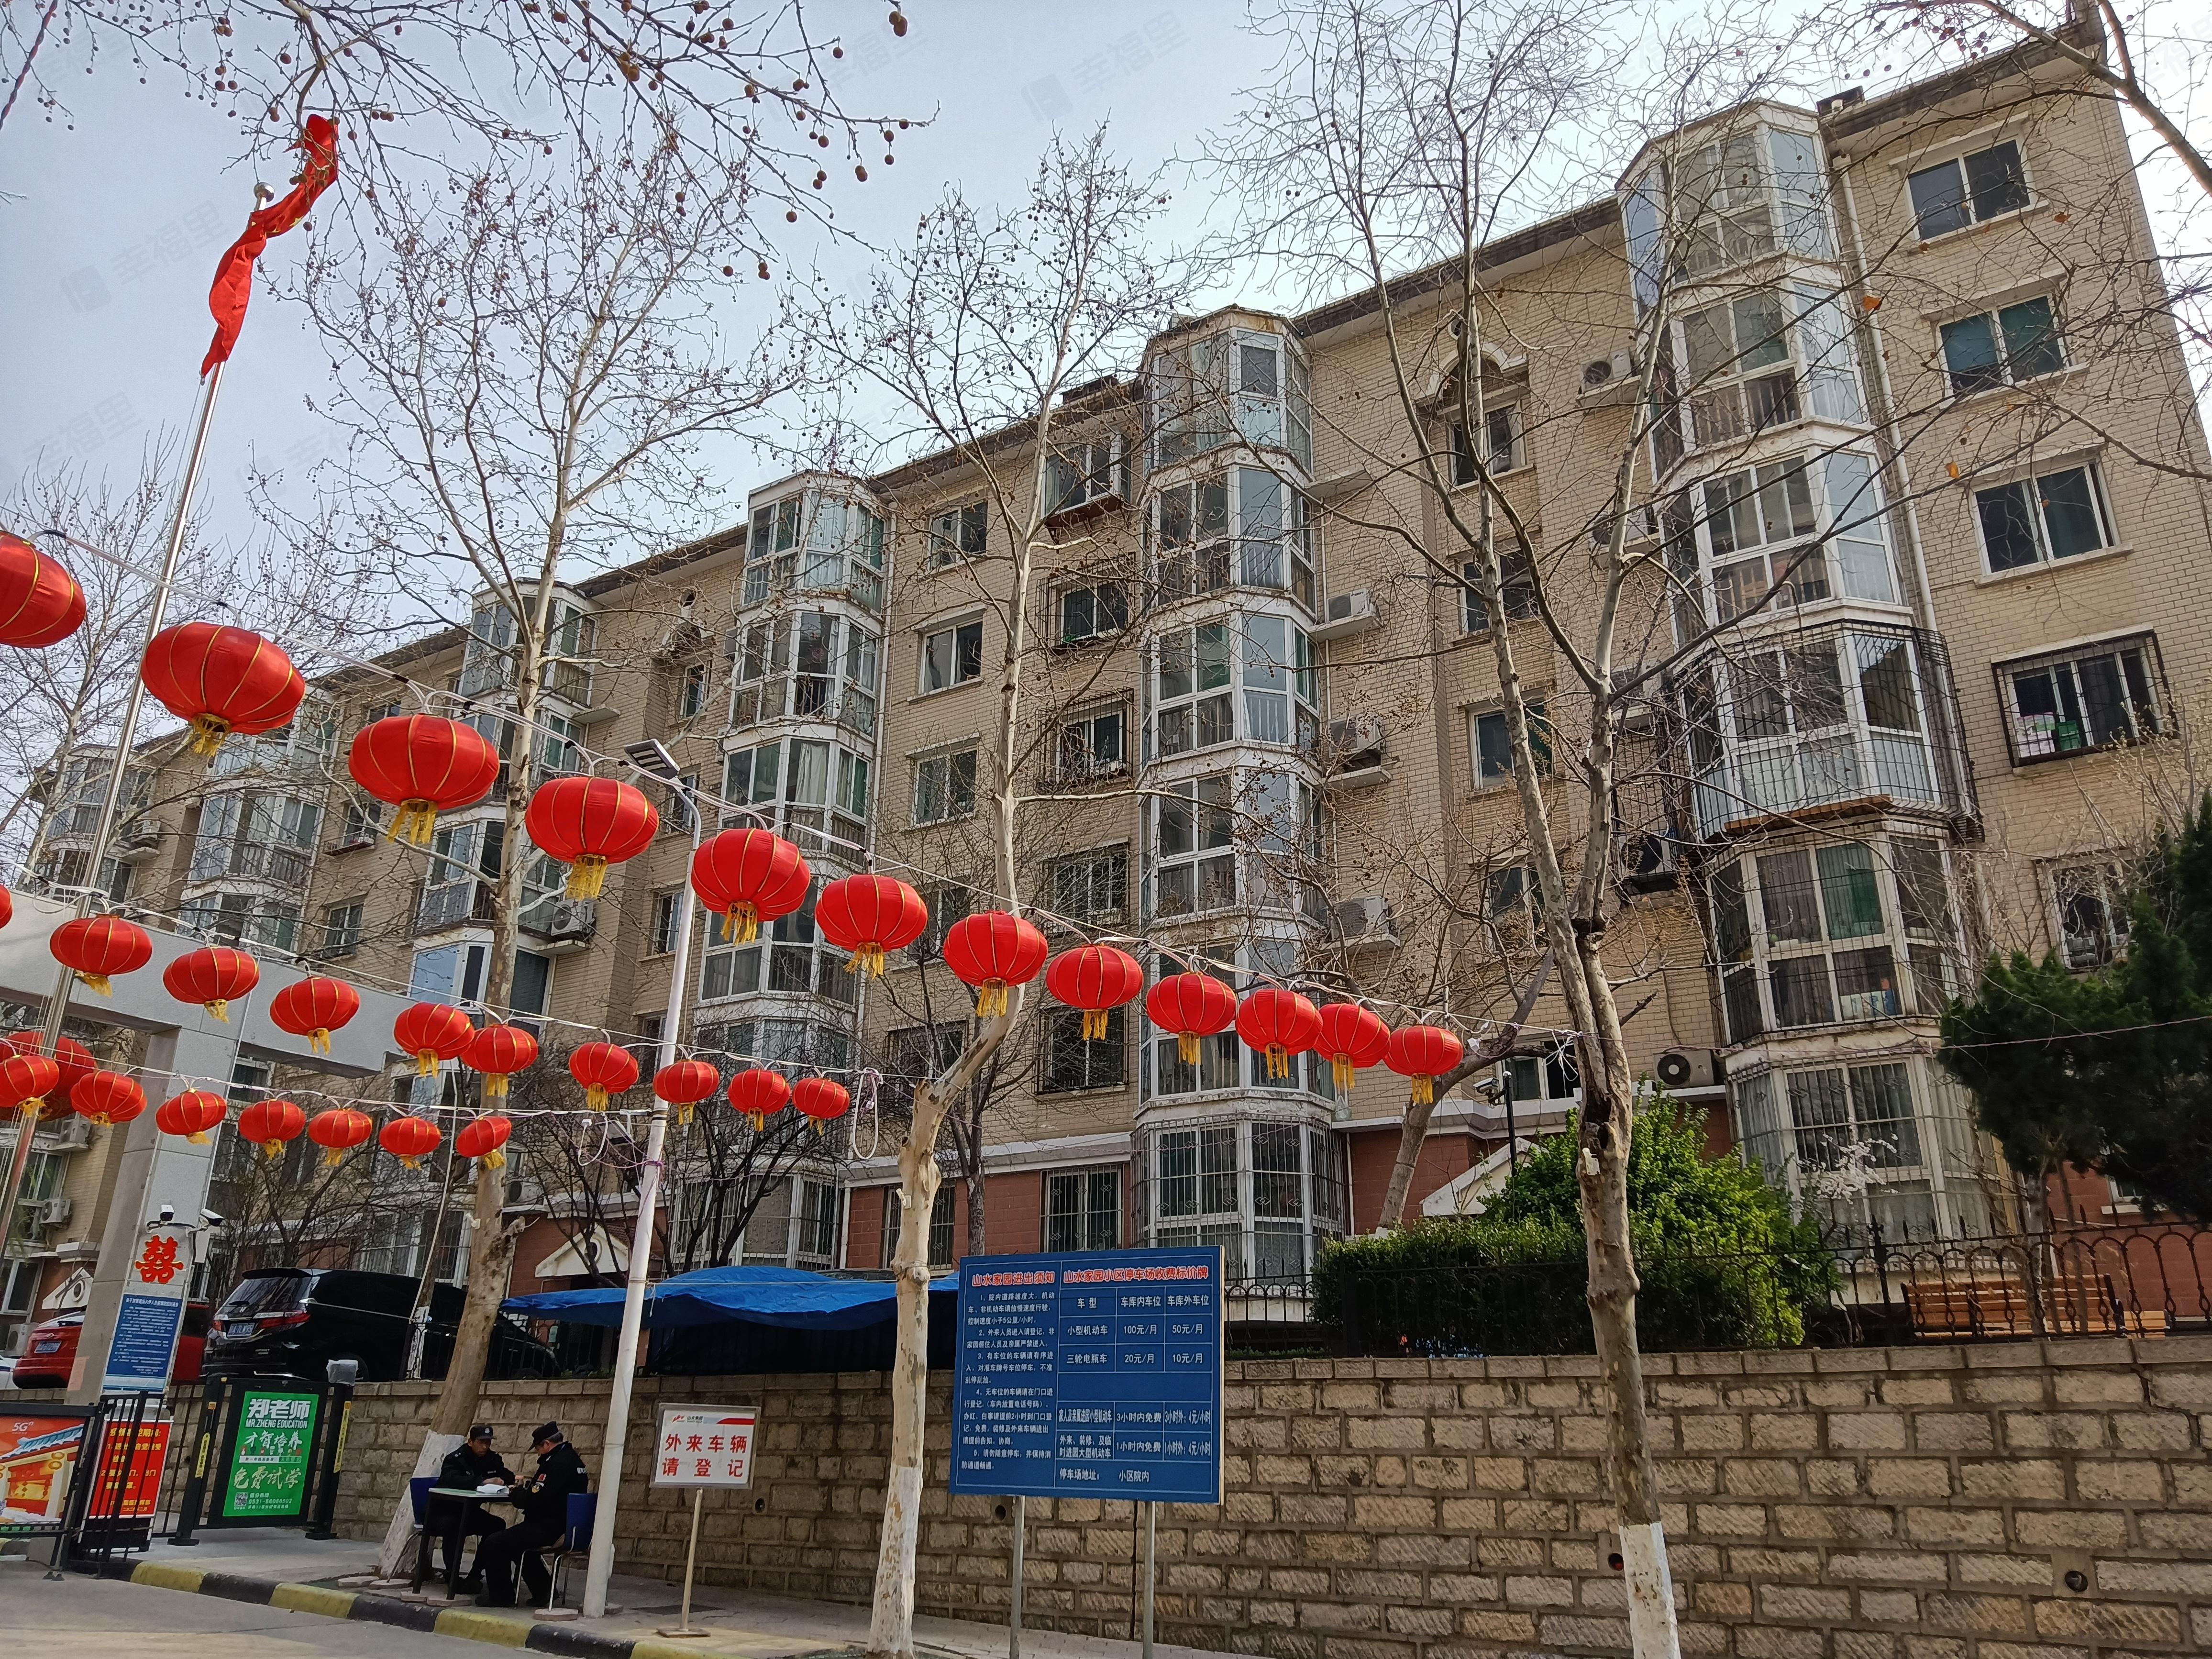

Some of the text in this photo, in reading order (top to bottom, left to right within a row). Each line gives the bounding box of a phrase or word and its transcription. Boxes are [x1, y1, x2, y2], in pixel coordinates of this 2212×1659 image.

[972, 1271, 1055, 1287] 山水家园进出须知
[1063, 1265, 1209, 1283] 山水家园小区停车场收费标价牌
[1121, 1295, 1161, 1307] 车库内车位
[1167, 1294, 1209, 1306] 车库外车位
[1067, 1325, 1108, 1335] 小型机动车
[1124, 1324, 1157, 1335] 100元/月
[1172, 1324, 1203, 1335] 50元/月
[1066, 1353, 1107, 1364] 三轮电瓶车
[1125, 1353, 1154, 1363] 20元/月
[1172, 1353, 1203, 1363] 10元/月
[247, 1398, 311, 1420] 郑老师
[245, 1419, 308, 1428] MR.ZHENG EDUCATION
[1117, 1412, 1161, 1423] 3小时内免费
[244, 1429, 302, 1450] 才智培养
[665, 1433, 748, 1453] 外来车辆
[1060, 1435, 1112, 1446] 外来、装修、及临
[1117, 1441, 1161, 1452] 1小时内免费
[1059, 1447, 1111, 1459] 时进园大型机动车
[662, 1457, 743, 1477] 请登记
[233, 1466, 301, 1490] 免费试学
[1060, 1468, 1099, 1481] 停车场地址：
[1119, 1470, 1149, 1482] 小区院内
